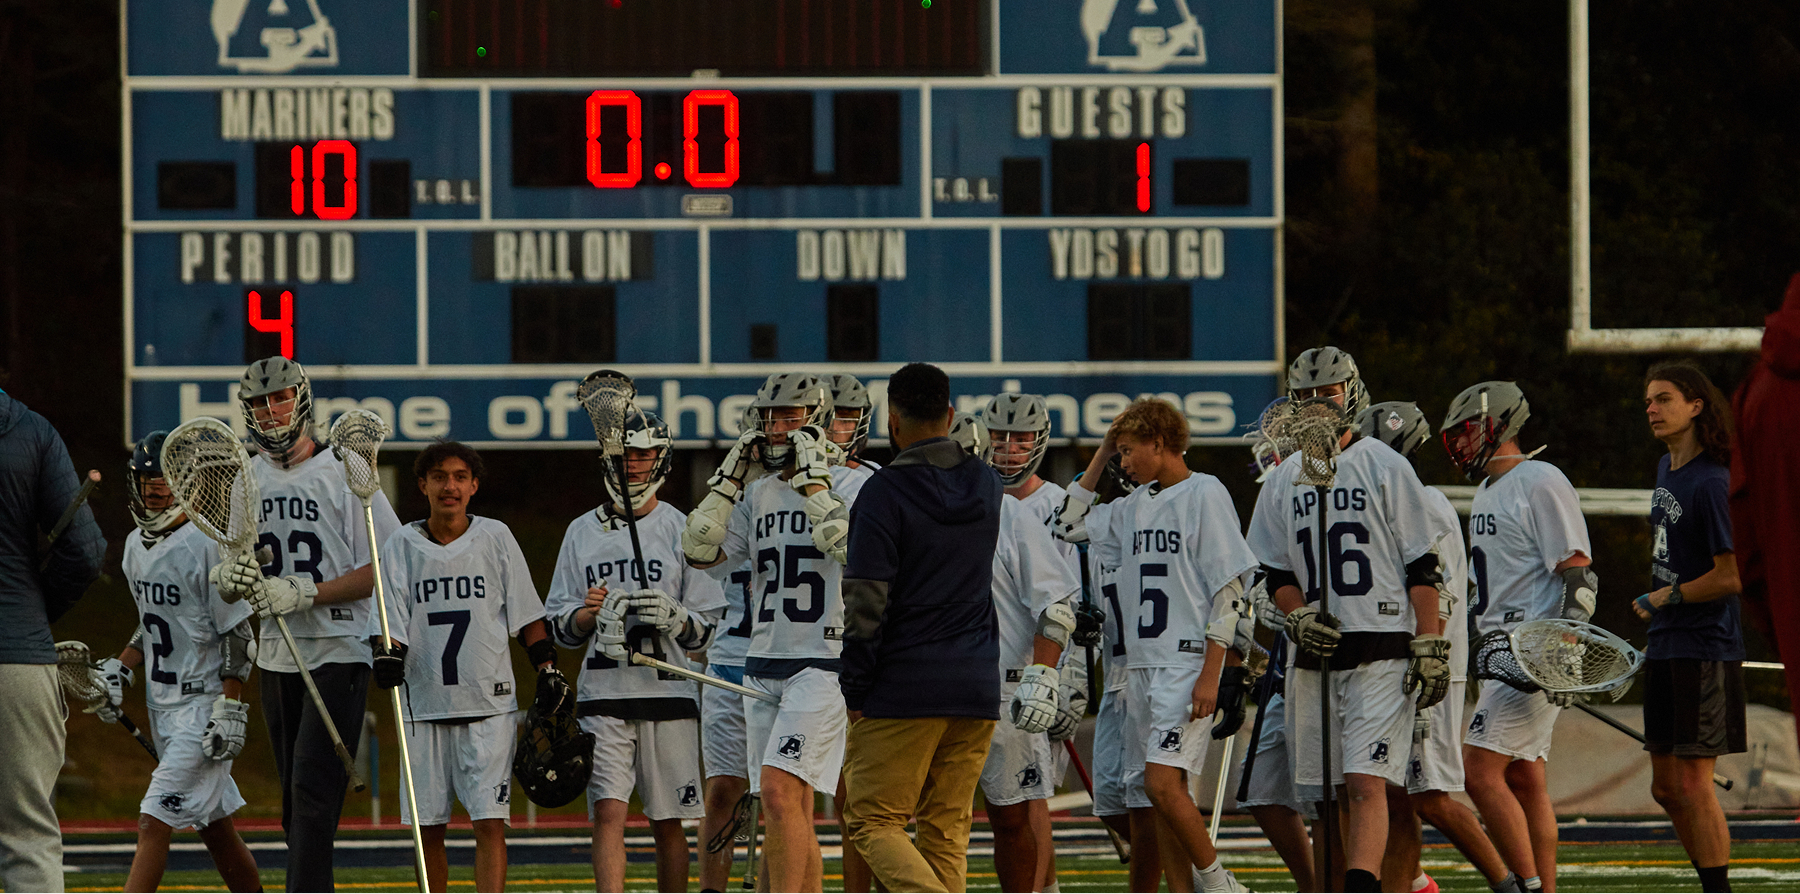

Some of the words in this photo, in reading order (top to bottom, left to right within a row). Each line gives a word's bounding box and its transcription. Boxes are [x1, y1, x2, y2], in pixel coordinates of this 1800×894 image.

[220, 87, 395, 141] MARINERS
[586, 89, 740, 188] 0.0
[1016, 85, 1187, 139] GUESTS
[290, 140, 358, 220] 10
[1136, 142, 1151, 213] 1
[180, 231, 355, 285] PERIOD
[494, 230, 575, 283] BALL
[581, 230, 632, 282] ON
[796, 230, 907, 282] DOWN
[1126, 227, 1171, 281] TO
[1175, 227, 1226, 281] GO
[248, 290, 294, 360] 4
[179, 382, 451, 440] Hme
[488, 380, 585, 440] of
[258, 496, 320, 523] PTOS
[1293, 487, 1367, 521] APOS
[757, 544, 826, 624] 25
[1296, 521, 1374, 603] 16
[1137, 563, 1169, 639] 5
[143, 612, 177, 685] 2
[427, 609, 471, 686] 7
